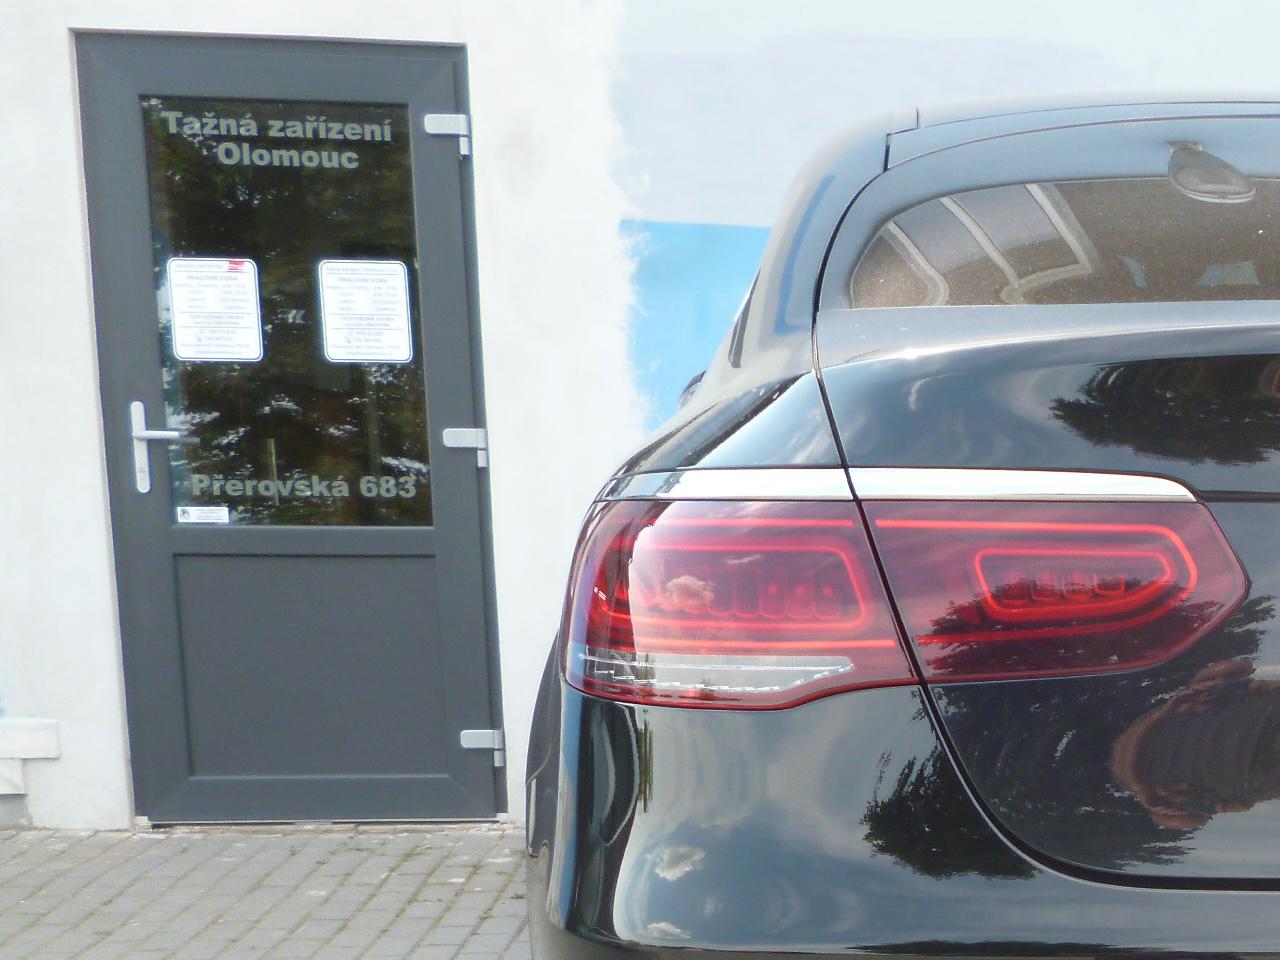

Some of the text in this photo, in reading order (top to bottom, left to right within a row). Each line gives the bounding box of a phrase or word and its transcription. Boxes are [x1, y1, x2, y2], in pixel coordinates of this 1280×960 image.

[161, 111, 392, 142] Tažná zařízení
[217, 142, 360, 169] Olomouc
[190, 474, 417, 498] Přerovská 683
